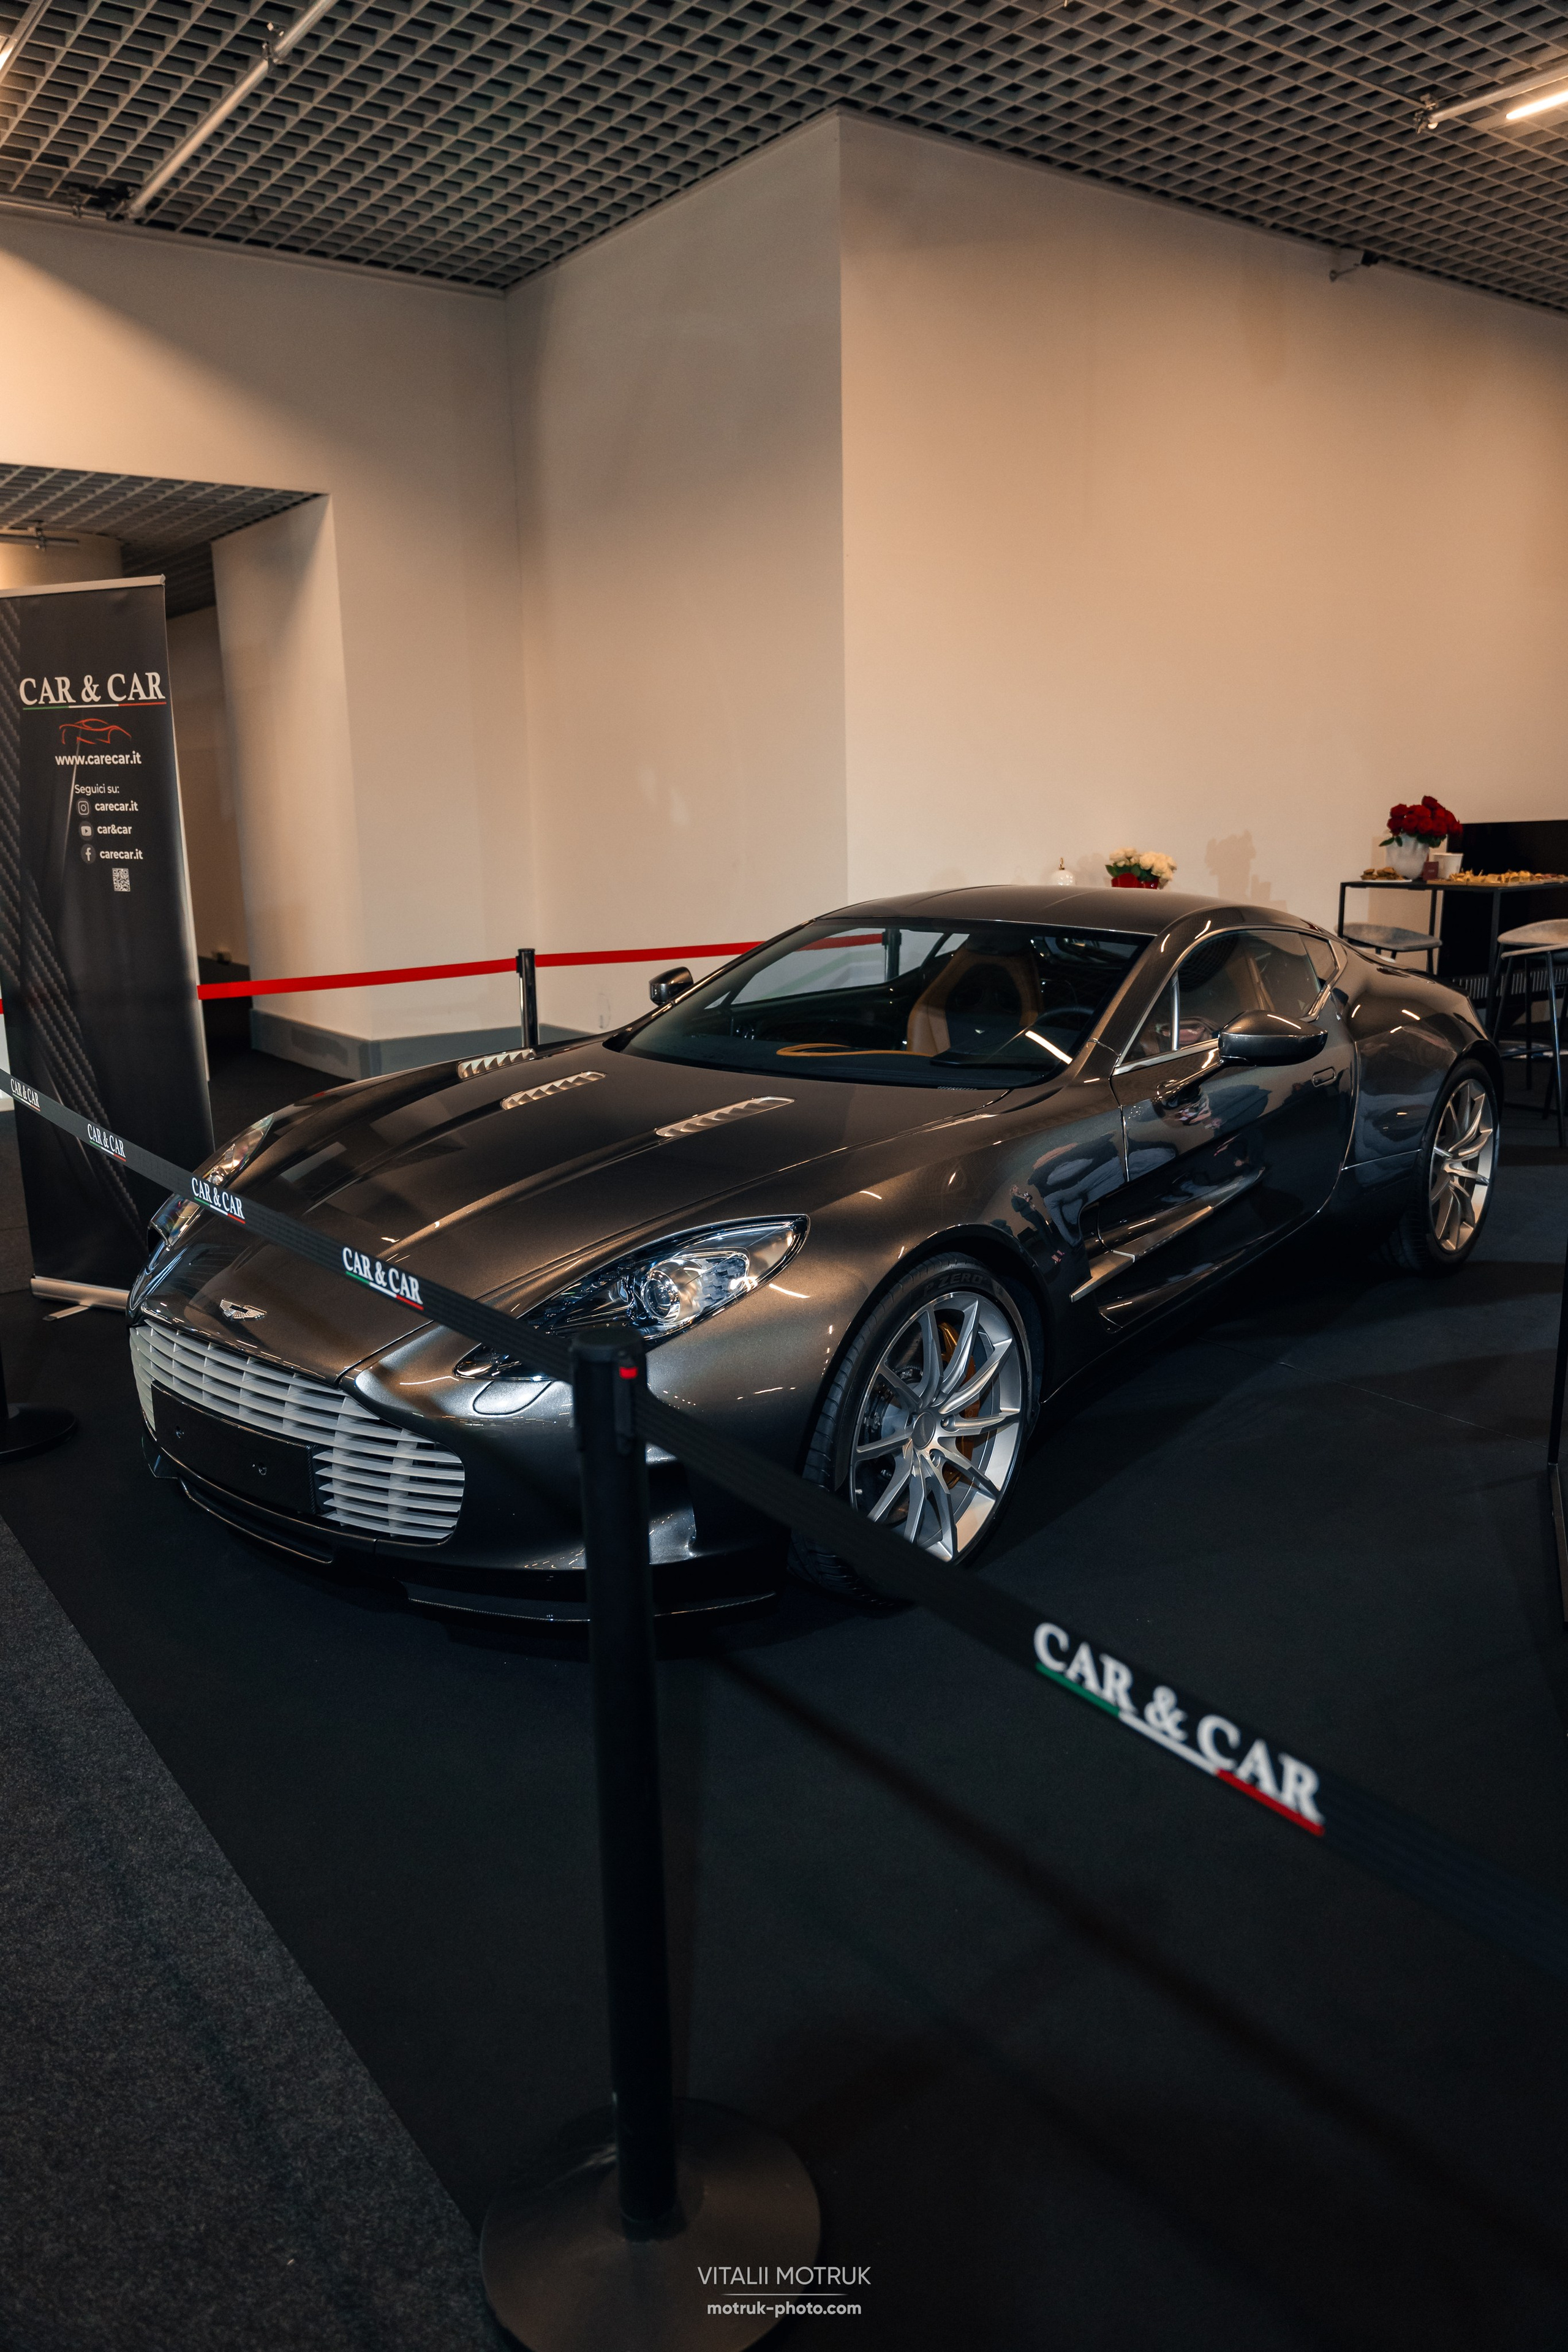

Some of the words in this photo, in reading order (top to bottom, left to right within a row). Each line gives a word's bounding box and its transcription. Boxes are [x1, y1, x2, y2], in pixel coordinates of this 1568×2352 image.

[20, 676, 75, 706] CAR
[81, 674, 101, 703] &
[107, 672, 165, 702] CAR
[55, 750, 141, 766] www.carecar.it
[74, 784, 106, 796] Seguici
[94, 800, 138, 812] carecar.it
[97, 824, 132, 835] car&car
[99, 849, 143, 860] carecar.it
[10, 1078, 23, 1097] CAR
[22, 1085, 28, 1100] &
[27, 1088, 40, 1108] CAR
[87, 1123, 103, 1146] CAR
[103, 1131, 109, 1148] &
[109, 1135, 126, 1158] CAR
[191, 1177, 213, 1204] CAR
[213, 1187, 221, 1207] &
[222, 1191, 245, 1219] CAR
[342, 1247, 374, 1281] CAR
[375, 1261, 387, 1287] &
[388, 1267, 423, 1305] CAR
[938, 1273, 983, 1289] ZERO
[1034, 1622, 1139, 1715] CAR
[1144, 1685, 1188, 1742] &
[1196, 1714, 1325, 1825] CAR
